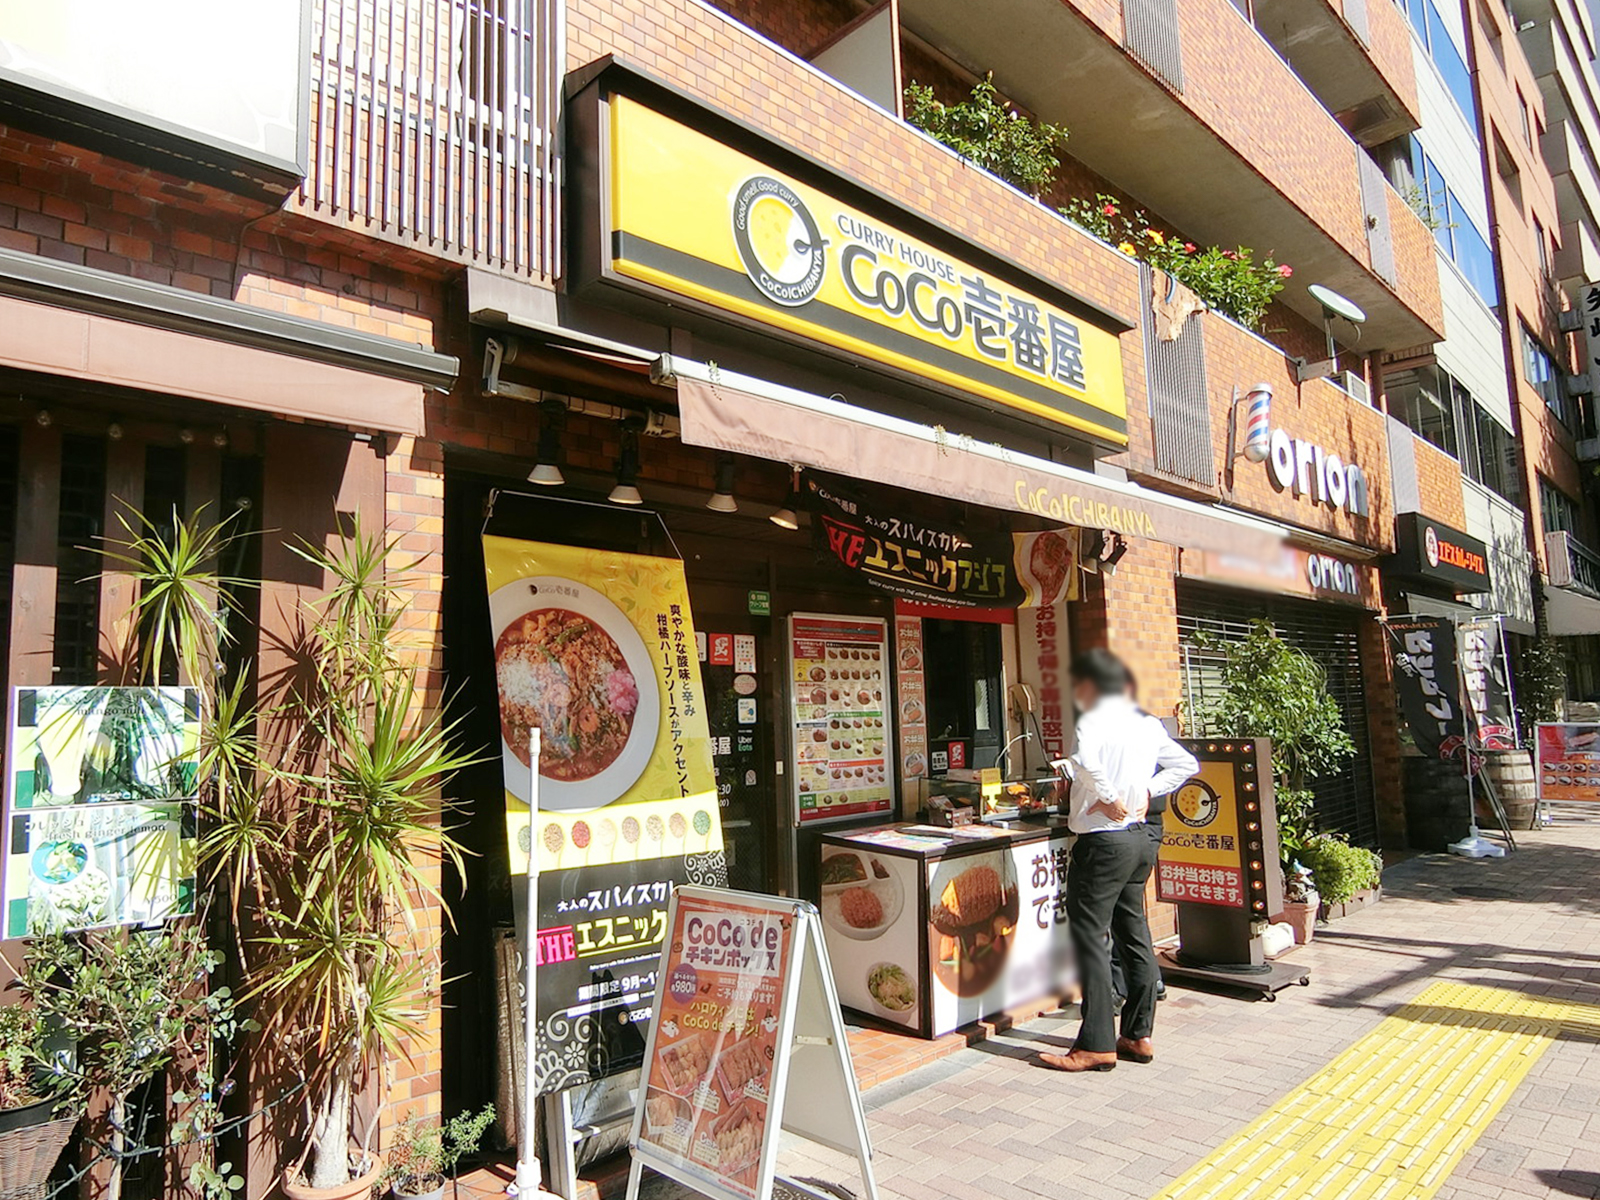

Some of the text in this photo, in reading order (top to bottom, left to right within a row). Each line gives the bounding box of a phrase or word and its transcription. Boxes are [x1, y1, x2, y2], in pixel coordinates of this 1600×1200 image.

[757, 180, 779, 193] Good
[779, 188, 799, 207] curry
[837, 214, 956, 283] CURRY HOUSE
[759, 249, 823, 300] CoCoICHIBANYA
[841, 243, 1087, 391] CoCo壱番屋
[1269, 428, 1369, 518] orion
[1015, 480, 1157, 538] CoCoICHIBANYA
[1307, 553, 1360, 595] orion
[669, 604, 696, 717] 爽やかな酸味と辛み
[656, 613, 690, 798] 柑橘ハーブソースがアクセント
[737, 736, 753, 744] Uber
[737, 744, 753, 752] Eats
[84, 826, 126, 839] ginger
[1161, 832, 1236, 852] CoCo壱番屋
[1160, 864, 1239, 887] お弁当お持ち
[1160, 880, 1244, 906] 帰りできます。
[687, 917, 779, 950] CoCo de
